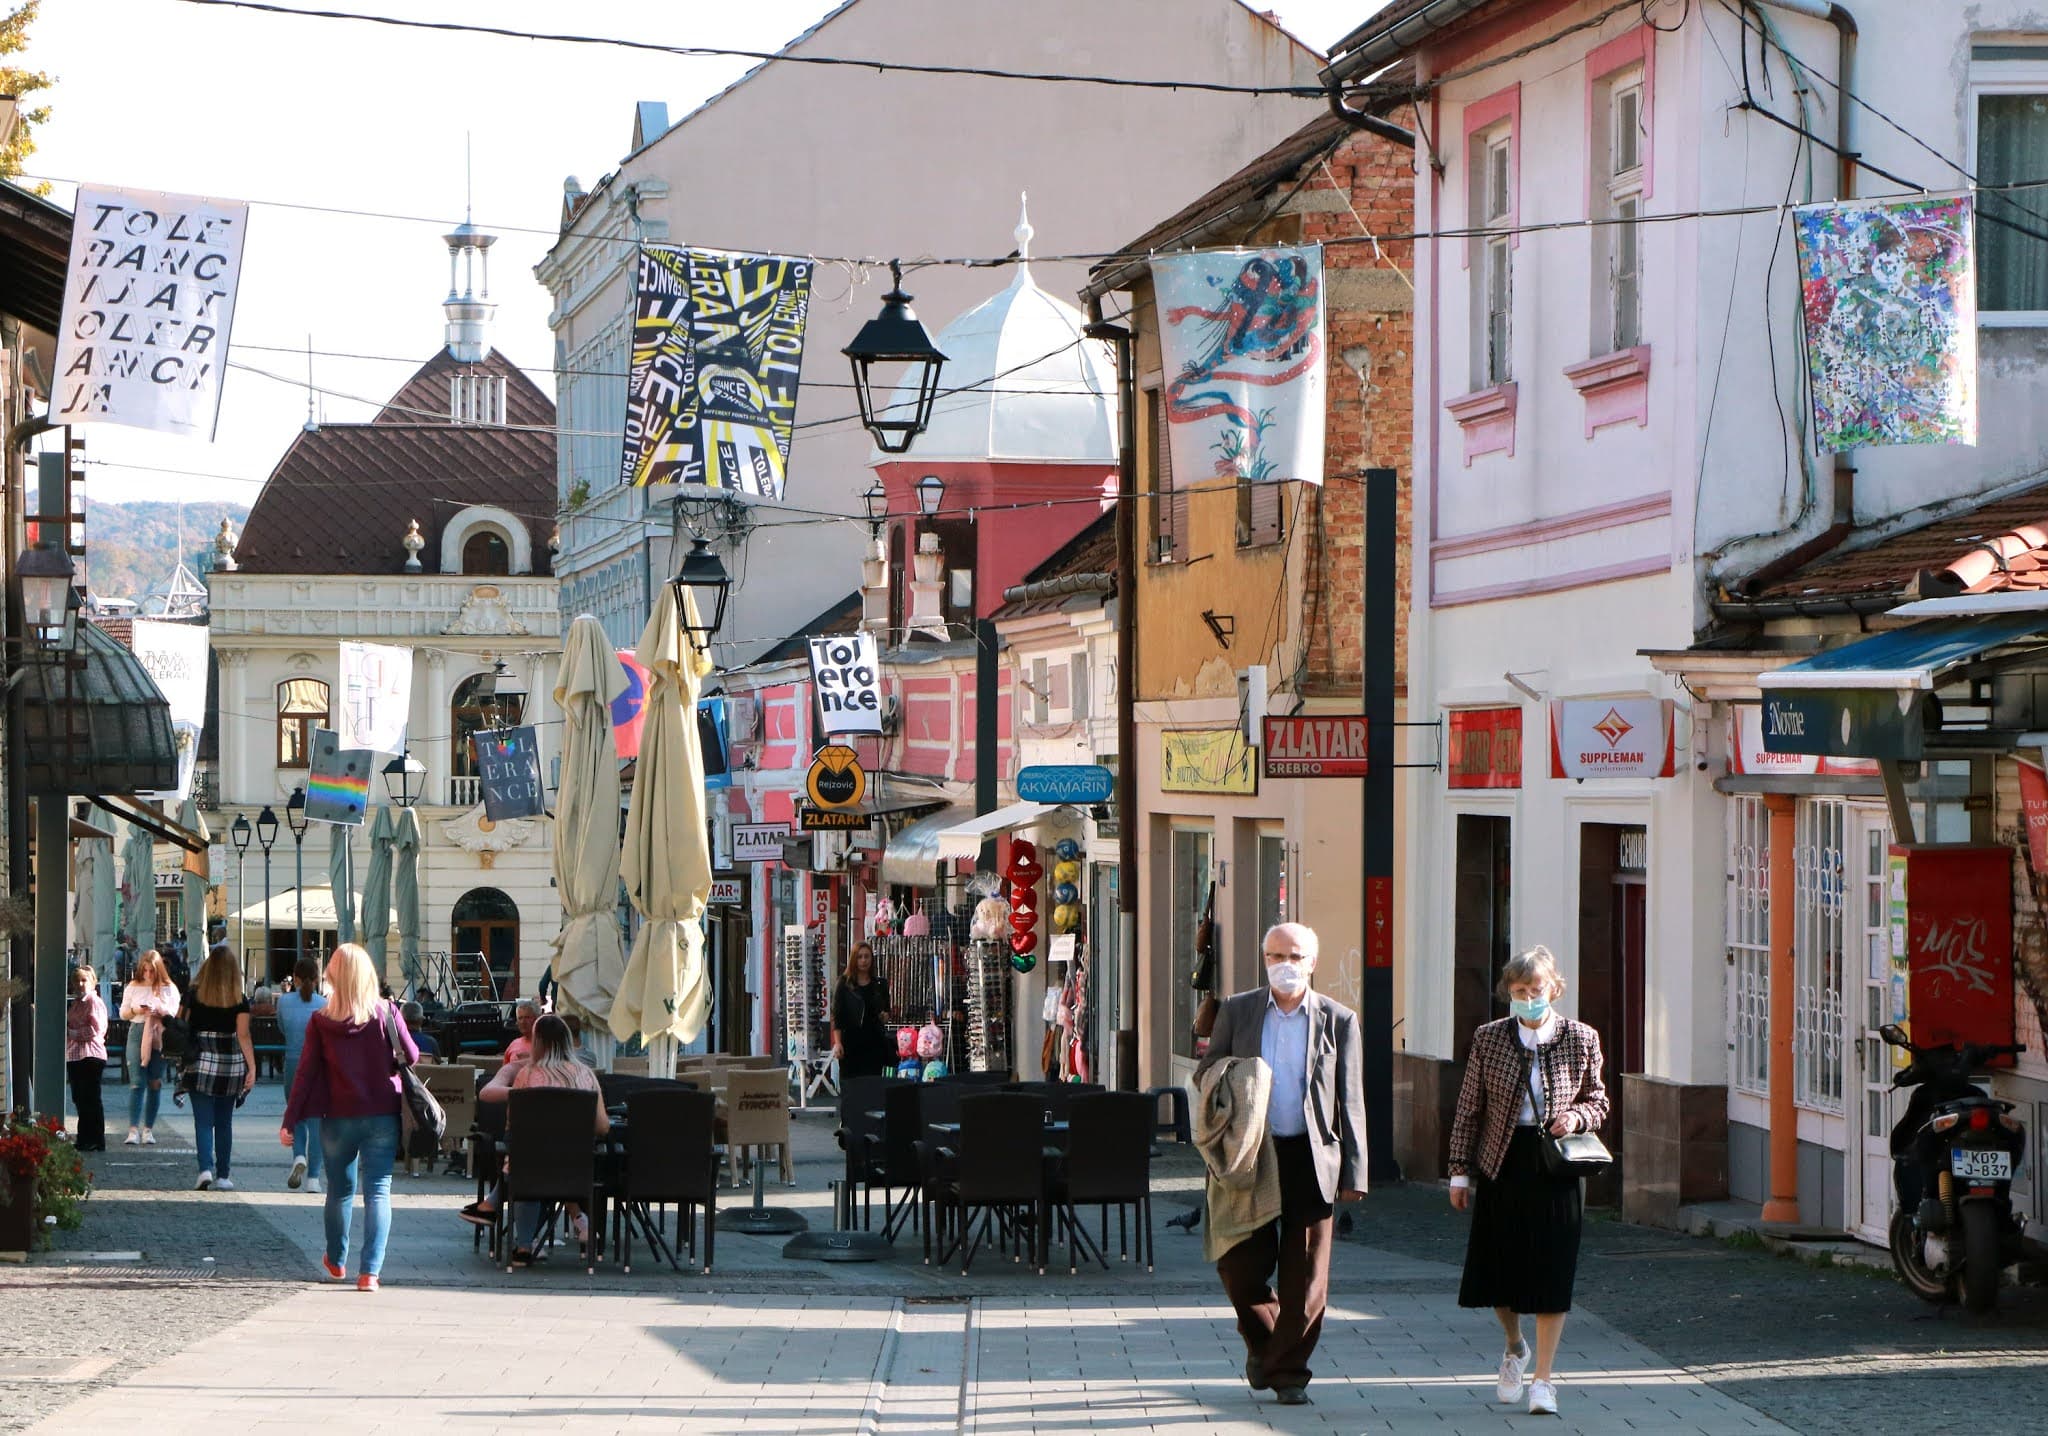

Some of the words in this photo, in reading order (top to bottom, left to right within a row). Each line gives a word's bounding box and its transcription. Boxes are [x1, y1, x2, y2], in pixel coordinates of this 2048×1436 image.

[1270, 721, 1366, 757] ZLATAR
[1580, 752, 1644, 763] SUPPLEMAN
[487, 760, 536, 779] ERA
[1269, 762, 1322, 773] SREBRO
[489, 782, 538, 801] NCE
[1020, 782, 1107, 793] AKVAMARIN
[805, 813, 865, 825] ZLATARA
